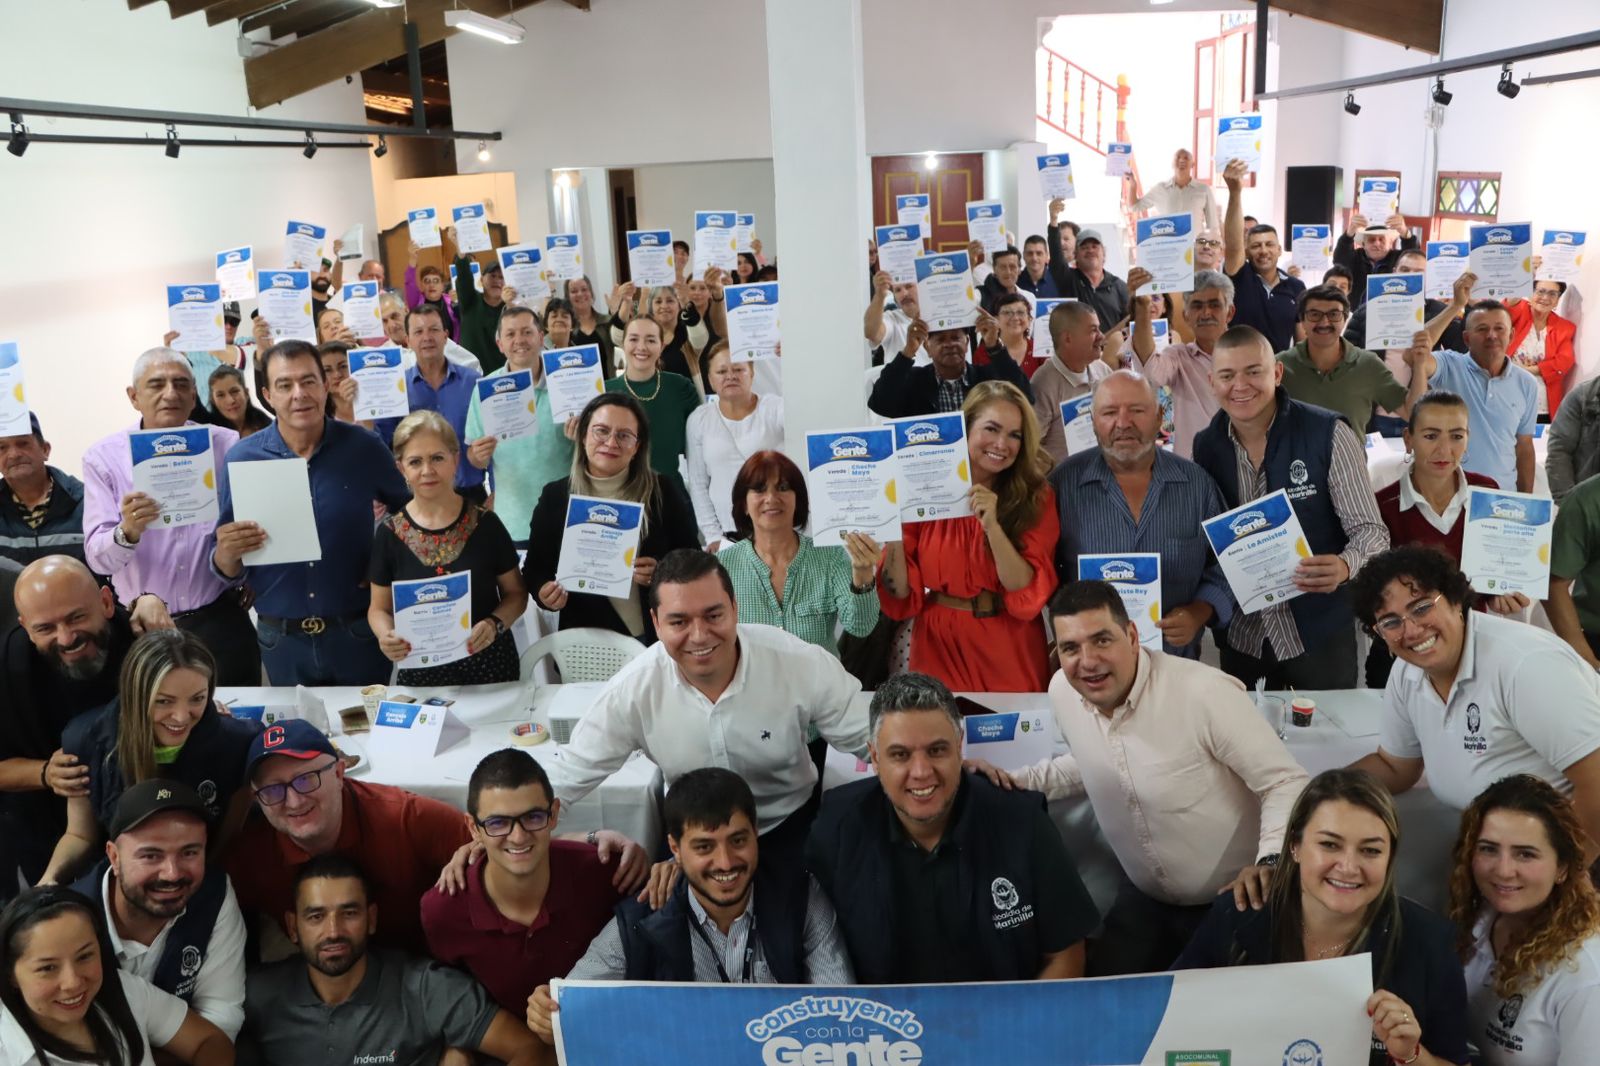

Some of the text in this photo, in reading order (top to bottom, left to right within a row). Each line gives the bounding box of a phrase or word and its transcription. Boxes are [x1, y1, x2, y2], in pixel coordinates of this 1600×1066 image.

[908, 431, 940, 443] Gente
[833, 445, 868, 457] Gente
[1234, 517, 1267, 535] Gente
[1257, 528, 1288, 545] Amistad
[1102, 569, 1135, 579] Gente
[264, 726, 285, 748] C
[1021, 904, 1032, 912] de
[746, 996, 923, 1043] Construyendo
[804, 1022, 865, 1039] con la
[761, 1035, 922, 1066] Gente
[1174, 1053, 1219, 1061] ASOCOMUNAL
